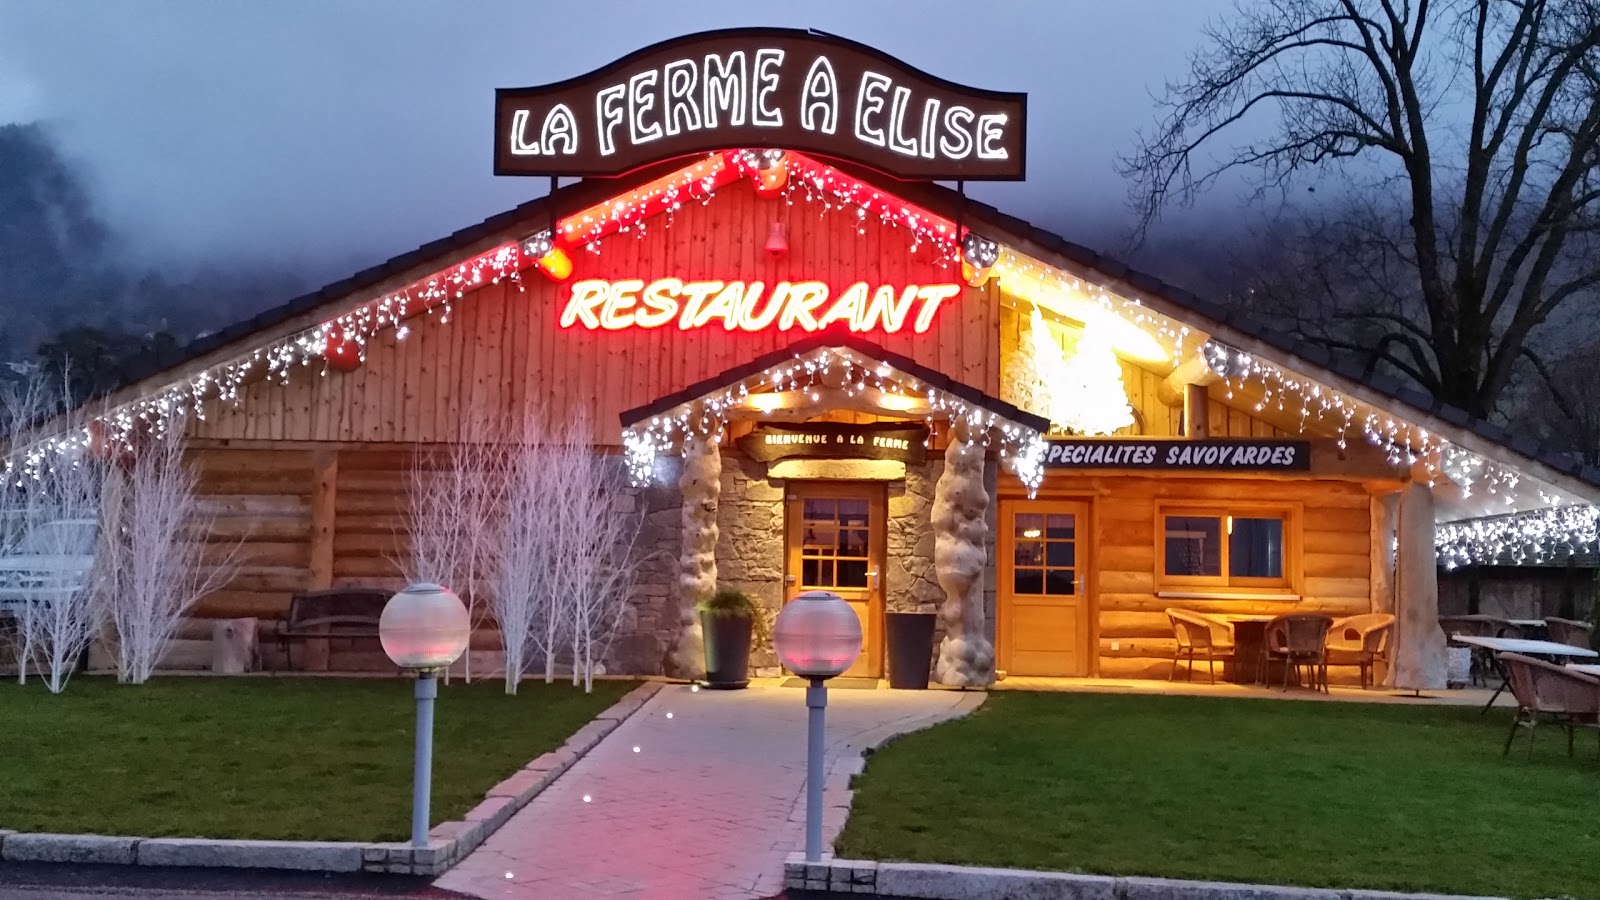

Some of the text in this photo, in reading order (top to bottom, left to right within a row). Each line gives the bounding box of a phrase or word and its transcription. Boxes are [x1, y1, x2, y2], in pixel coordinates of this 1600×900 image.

[510, 49, 1008, 159] LA FERME A ELISE
[560, 278, 960, 333] RESTAURANT
[765, 434, 909, 450] BIENVENUE A LA FERME
[1166, 446, 1296, 465] SAVOYARDES
